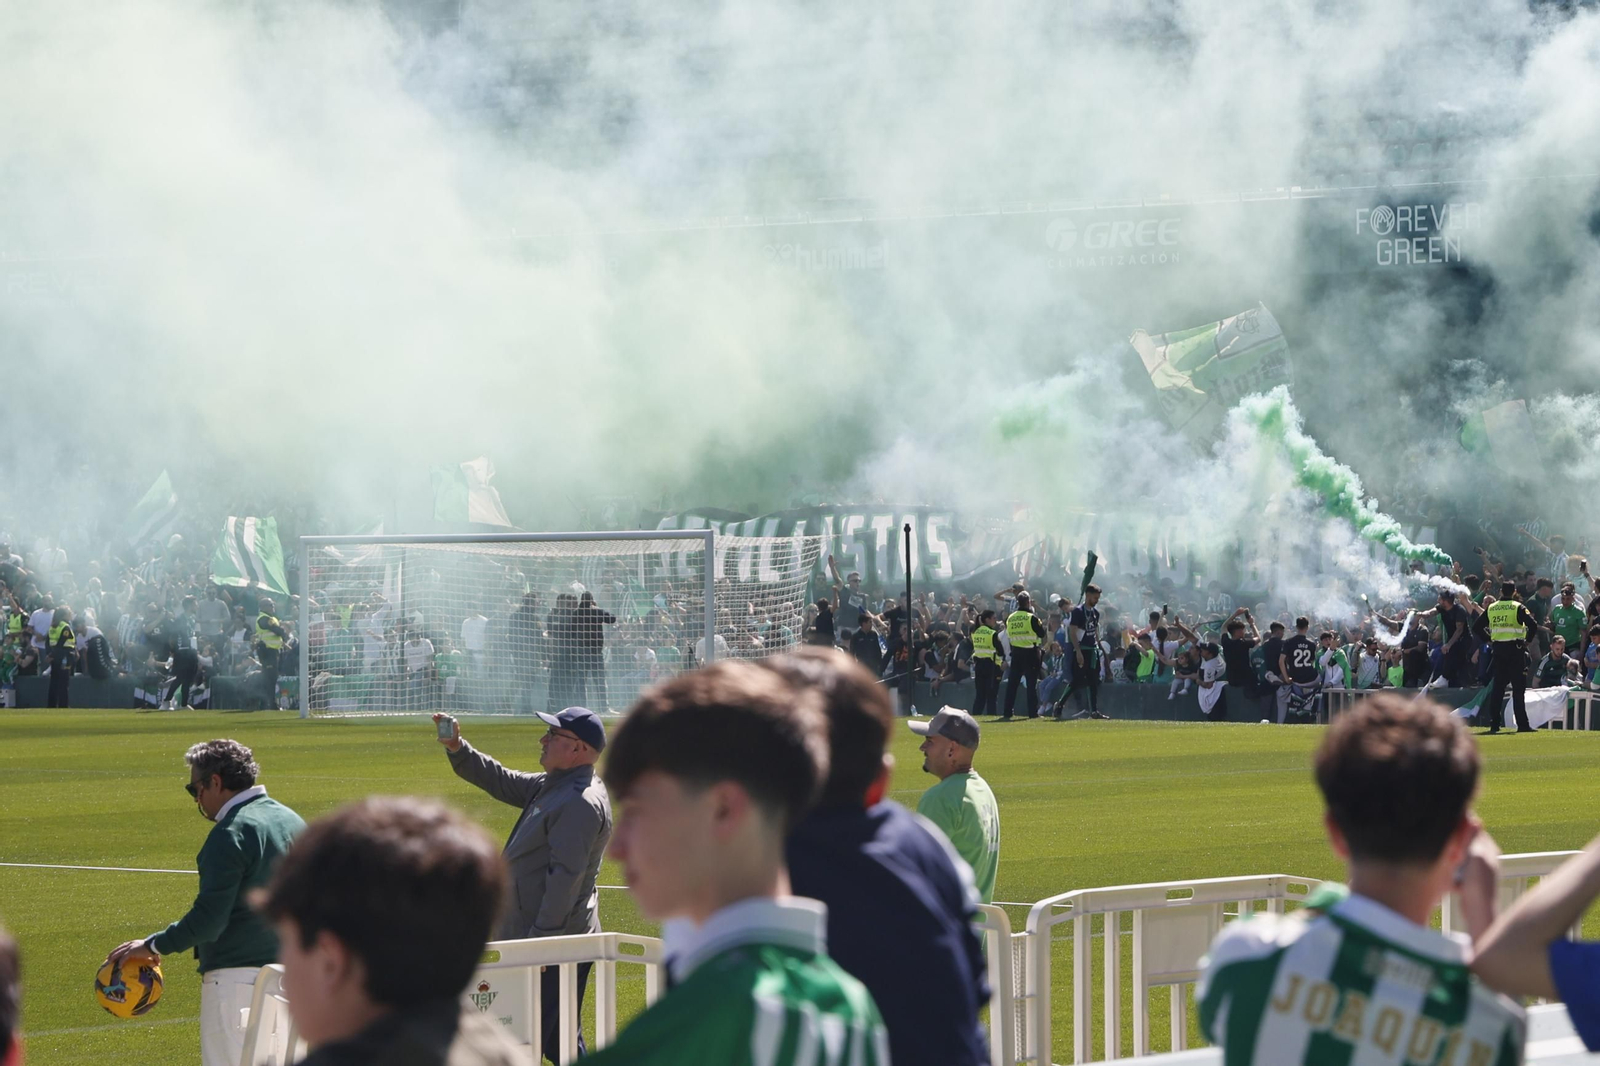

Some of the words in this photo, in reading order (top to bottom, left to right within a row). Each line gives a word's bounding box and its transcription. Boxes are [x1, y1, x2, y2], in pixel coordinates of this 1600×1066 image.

[1083, 217, 1182, 250] GREE
[1356, 202, 1481, 236] FOREVER
[794, 237, 890, 271] hummel
[1047, 251, 1180, 269] CLIMATIZACIÓN
[1376, 236, 1463, 265] GREEN
[1011, 621, 1024, 629] 2500
[1293, 649, 1312, 668] 22
[1269, 972, 1495, 1066] JOAQUIN
